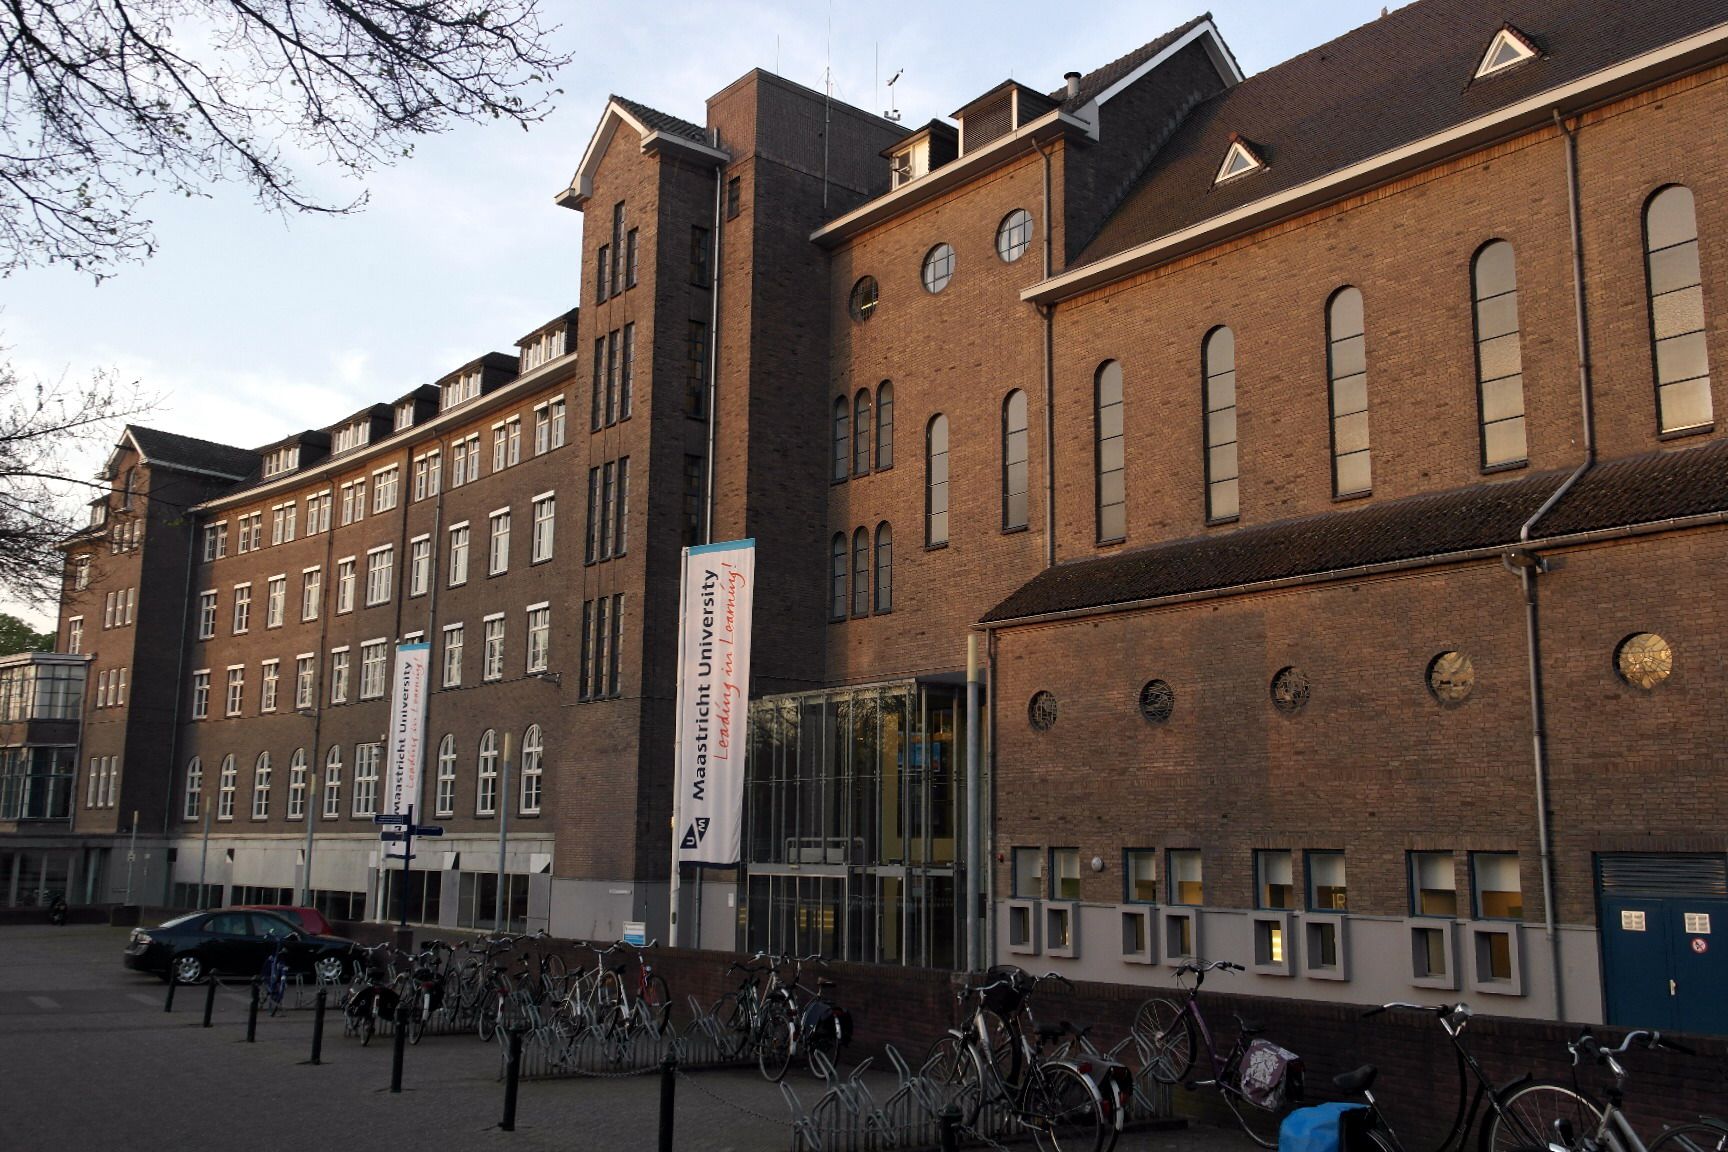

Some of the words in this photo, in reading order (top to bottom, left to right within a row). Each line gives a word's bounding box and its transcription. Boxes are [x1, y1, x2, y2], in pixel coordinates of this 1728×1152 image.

[698, 569, 719, 677] University
[399, 661, 412, 733] University
[721, 653, 733, 677] in
[693, 683, 711, 800] Maastricht
[714, 682, 741, 760] Leading
